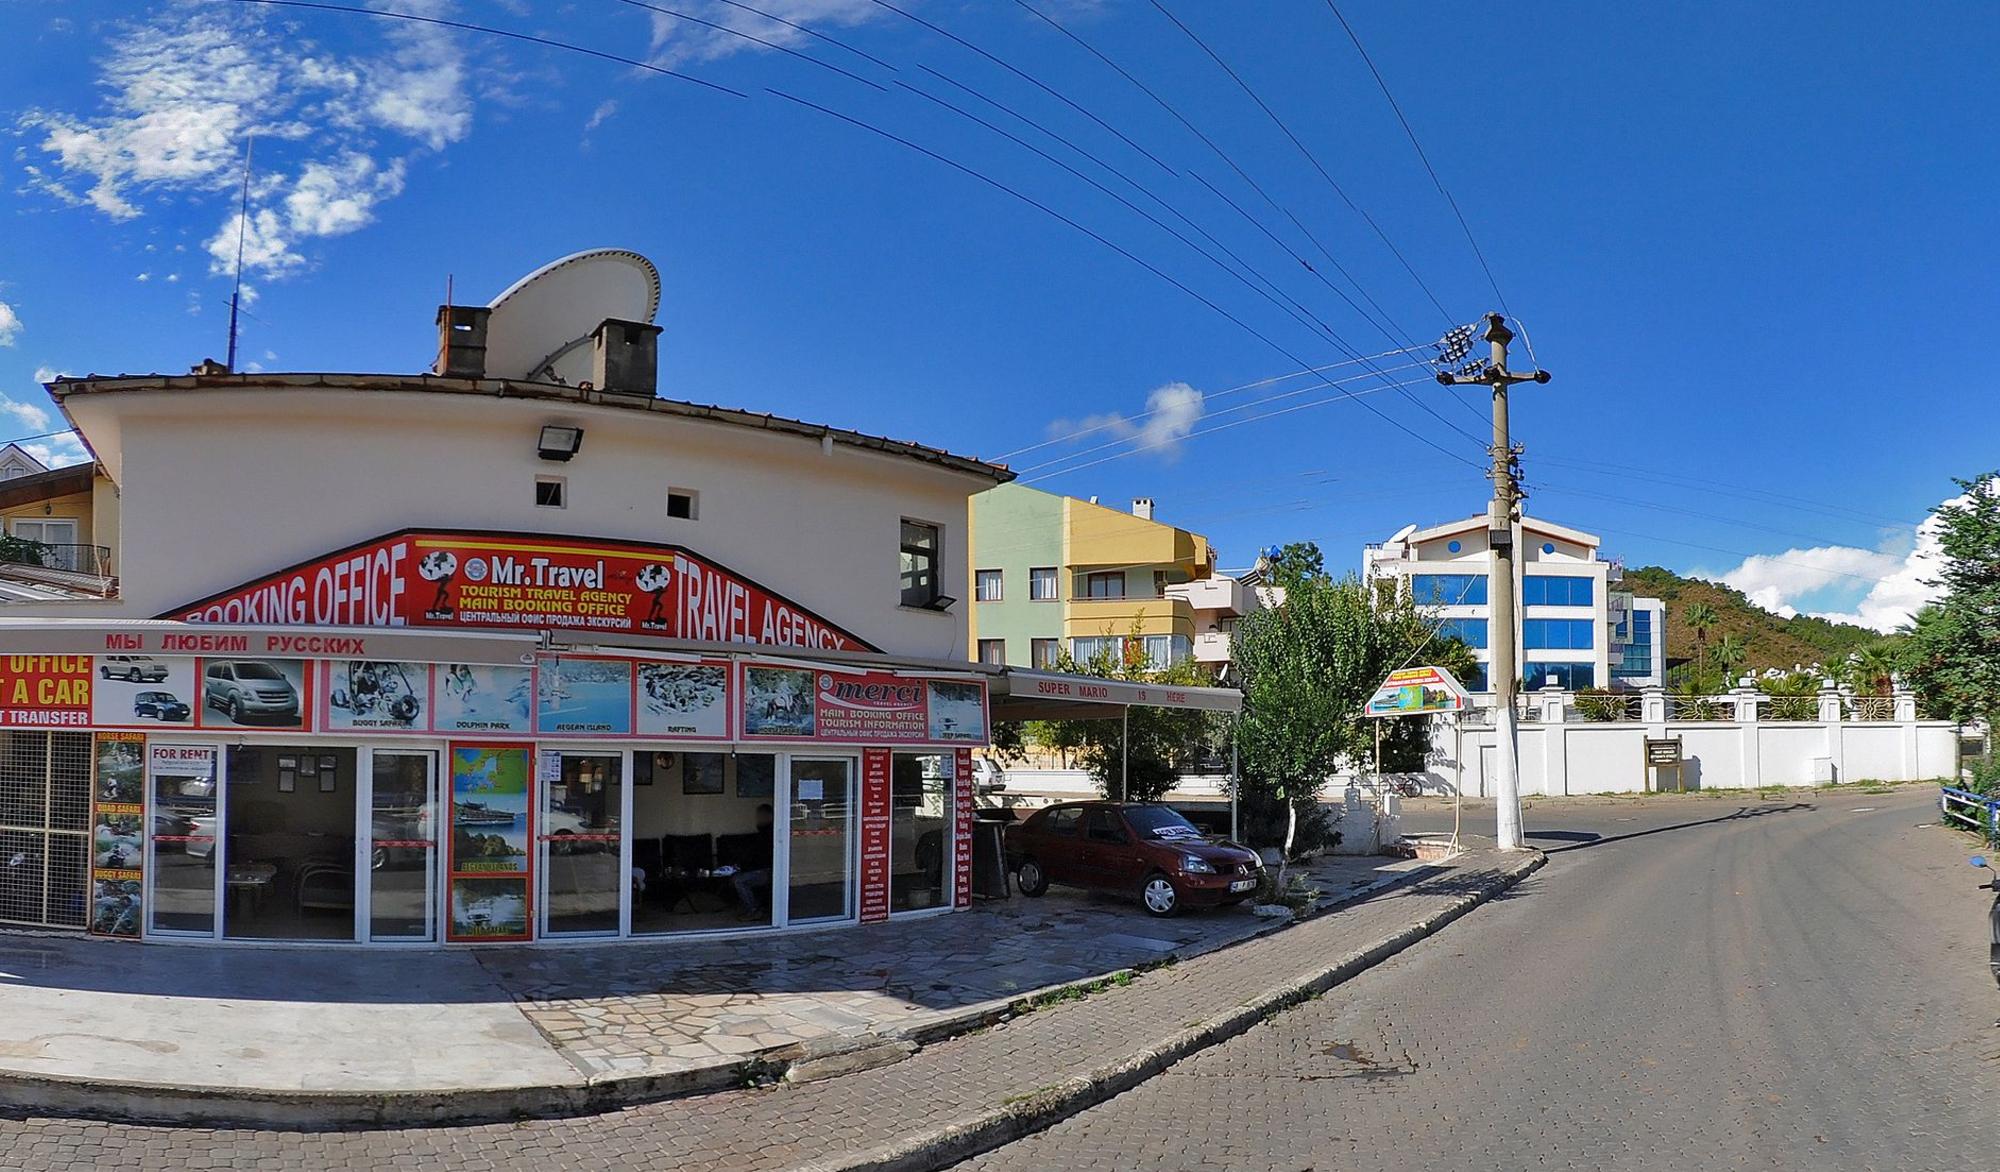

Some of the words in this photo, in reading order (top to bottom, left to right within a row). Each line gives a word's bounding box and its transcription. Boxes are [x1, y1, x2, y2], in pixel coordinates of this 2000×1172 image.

[491, 556, 604, 589] Mr.Travel
[314, 543, 407, 626] OFFICE
[460, 585, 521, 598] TOURISM
[526, 588, 577, 600] TRAVEL
[580, 591, 632, 604] AGENCY
[674, 554, 757, 644] TRAVEL
[761, 599, 845, 651] AGENCY
[460, 597, 498, 610] MAIN
[503, 600, 572, 613] BOOKING
[577, 602, 626, 616] OFFICE
[460, 610, 520, 623] ЦЕНТРАЛЬНЫЙ
[521, 613, 545, 625] ОФИС
[546, 614, 586, 627] ПРОДАЖА
[587, 616, 632, 629] ЭКСКУРСИЙ
[106, 633, 143, 650] МЫ
[161, 634, 248, 651] ЛЮБИМ
[267, 636, 365, 655] РУССКИХ
[10, 656, 89, 674] OFFICE
[12, 679, 29, 704] A
[38, 679, 89, 705] CAR
[835, 679, 923, 704] merci
[1038, 681, 1071, 695] SUPER
[1079, 685, 1108, 698] MARIO
[1138, 690, 1147, 701] IS
[1166, 691, 1186, 703] HERE
[9, 710, 88, 725] TRANSFER
[820, 709, 845, 718] MAIN
[850, 710, 892, 719] BOOKING
[896, 712, 925, 721] OFFICE
[820, 719, 861, 728] TOURISM
[864, 721, 925, 730] INFORMATION
[456, 721, 488, 729] DOLPHIN
[153, 748, 176, 760] FOR
[180, 749, 210, 761] RENT
